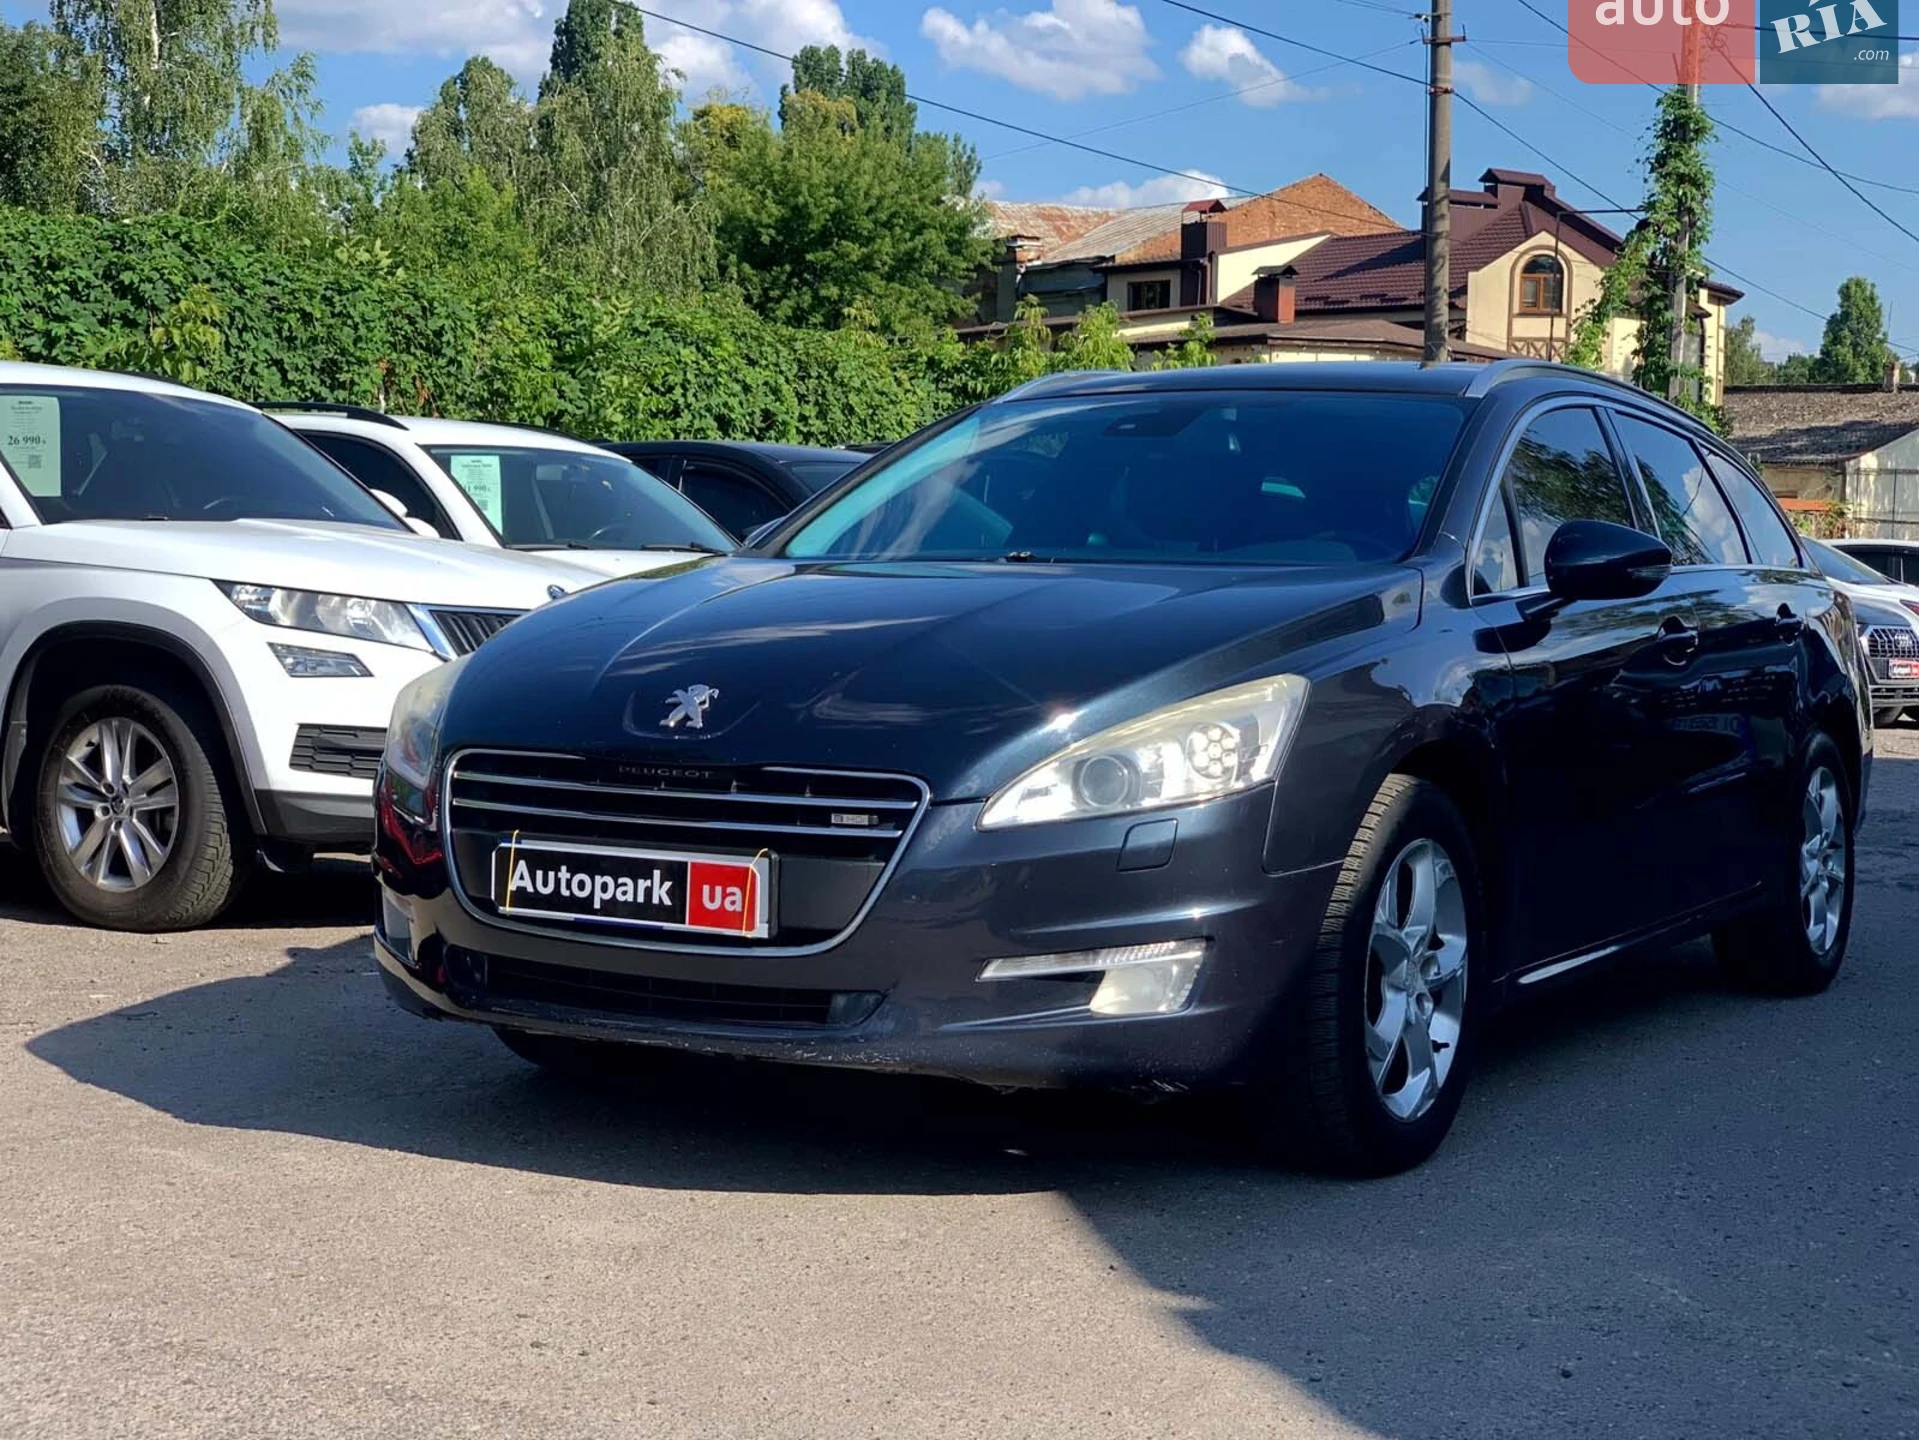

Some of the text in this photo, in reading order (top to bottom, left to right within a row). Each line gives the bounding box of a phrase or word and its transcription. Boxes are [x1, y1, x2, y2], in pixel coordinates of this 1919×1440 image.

[7, 435, 20, 446] 26
[22, 435, 41, 445] 990
[619, 765, 714, 779] PEUGEOT
[510, 859, 743, 912] Autopark ua
